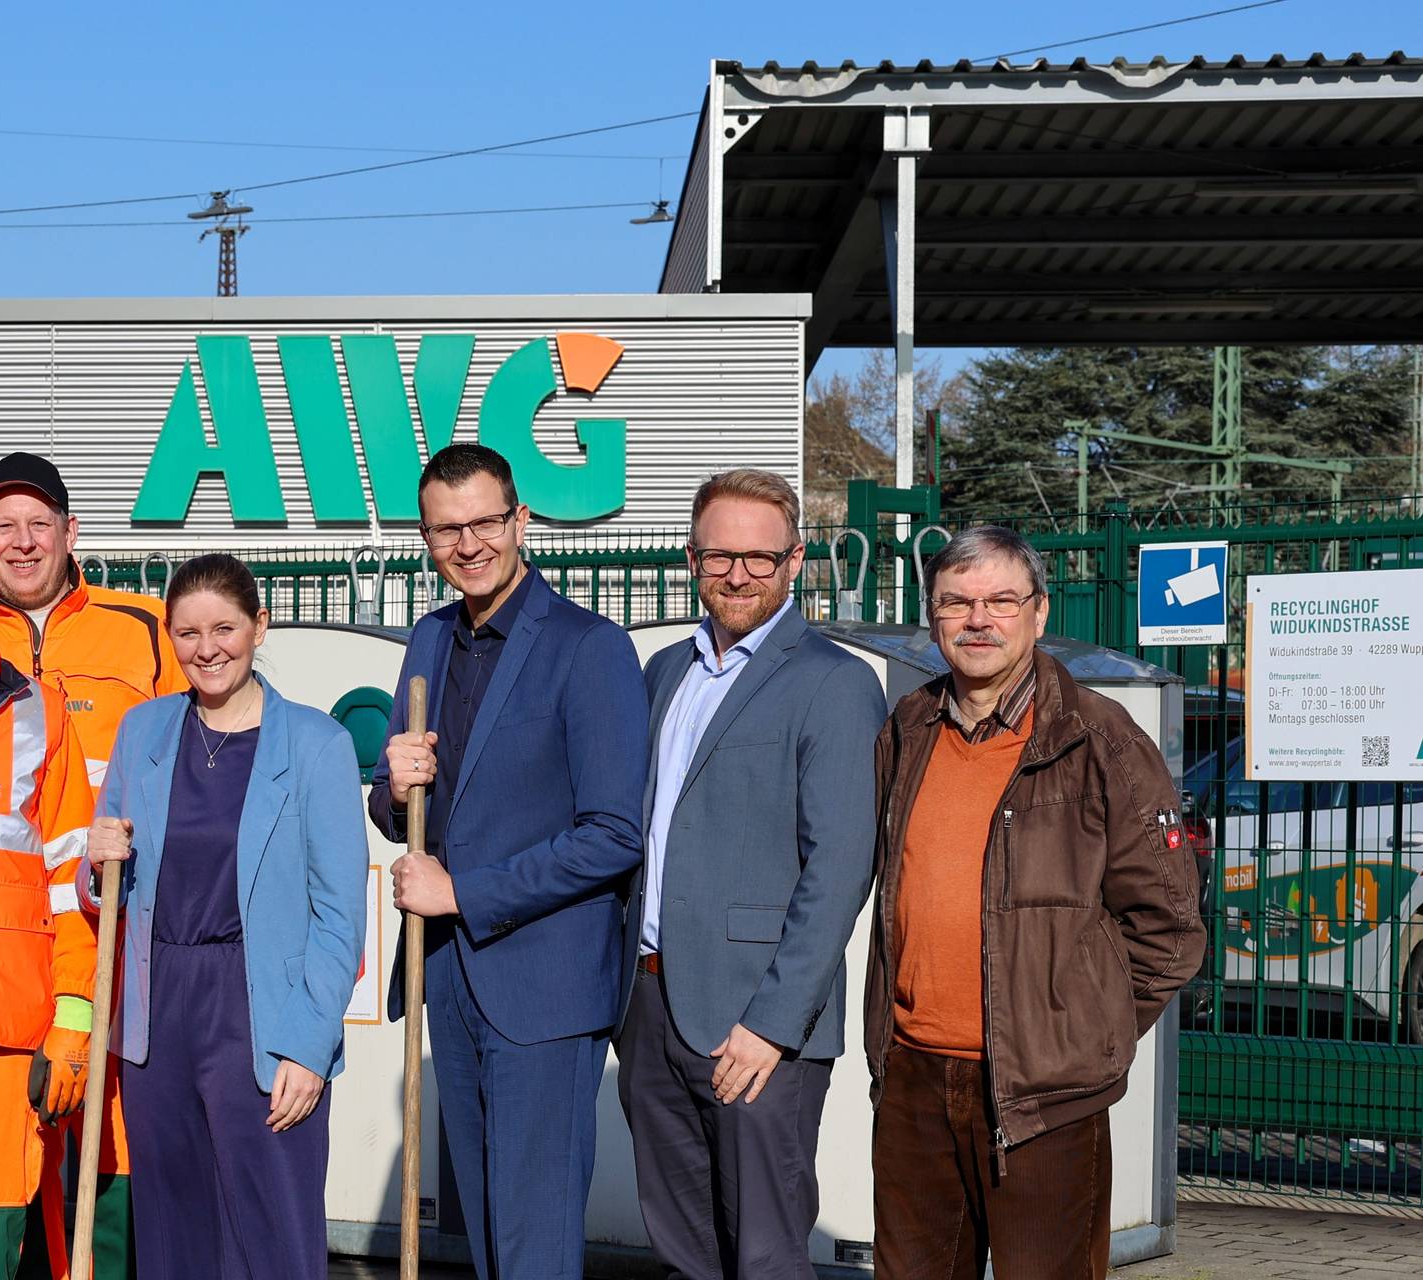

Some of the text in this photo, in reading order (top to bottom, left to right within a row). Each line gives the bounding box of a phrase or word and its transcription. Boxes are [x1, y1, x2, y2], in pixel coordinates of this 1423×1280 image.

[130, 333, 627, 522] AWG
[1270, 598, 1379, 616] RECYCLINGHOF
[1270, 616, 1410, 634] WIDUKINDSTRASSE
[1269, 645, 1337, 657] Widukindstraße
[1341, 645, 1353, 655] 39
[1368, 644, 1398, 655] 42289
[1268, 672, 1322, 681] Öffnungszeiten:
[1268, 686, 1294, 697] Di-Fr:
[1302, 686, 1328, 697] 10:00
[1340, 686, 1366, 696] 18:00
[1369, 685, 1385, 696] Uhr
[1268, 700, 1283, 711] Sa:
[1301, 700, 1328, 710] 07:30
[1340, 699, 1366, 710] 16:00
[1369, 699, 1385, 709] Uhr
[1268, 713, 1365, 725] Montags geschlossen
[1295, 747, 1345, 757] Recyclinghöfe:
